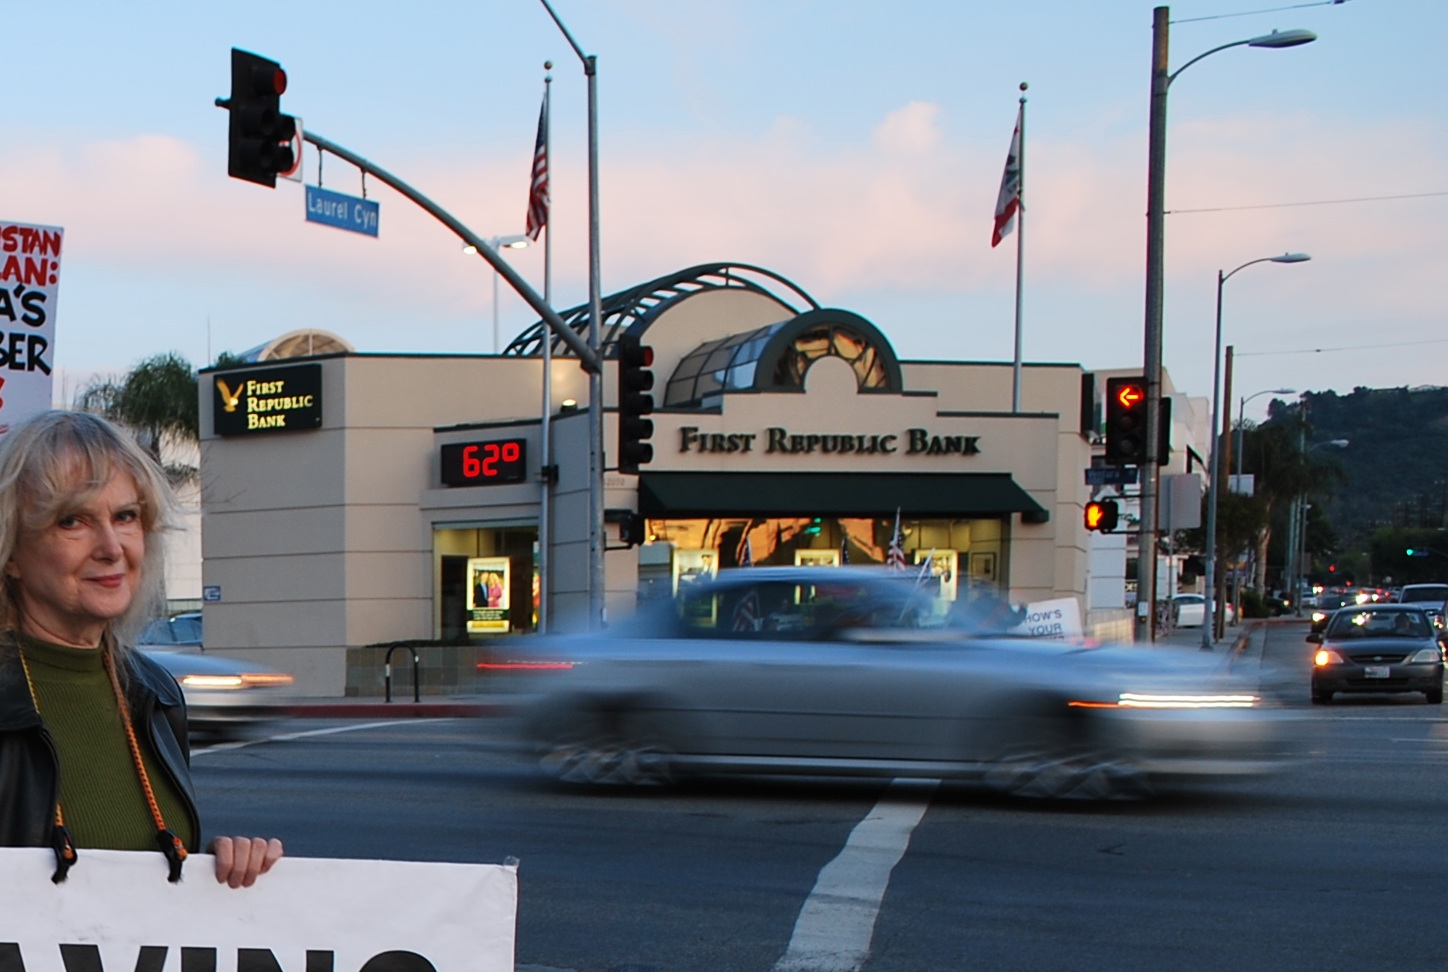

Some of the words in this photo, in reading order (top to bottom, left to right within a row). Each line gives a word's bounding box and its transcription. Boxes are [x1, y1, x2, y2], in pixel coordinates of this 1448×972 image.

[308, 192, 348, 220] Laurel
[354, 204, 377, 228] Cyn
[247, 380, 284, 396] FIRST
[247, 395, 313, 412] REPUBLIC
[248, 413, 286, 430] BANK
[679, 426, 756, 453] FIRST
[765, 427, 897, 453] REPUBLIC
[905, 428, 981, 455] BANK
[1028, 623, 1062, 636] YOUR
